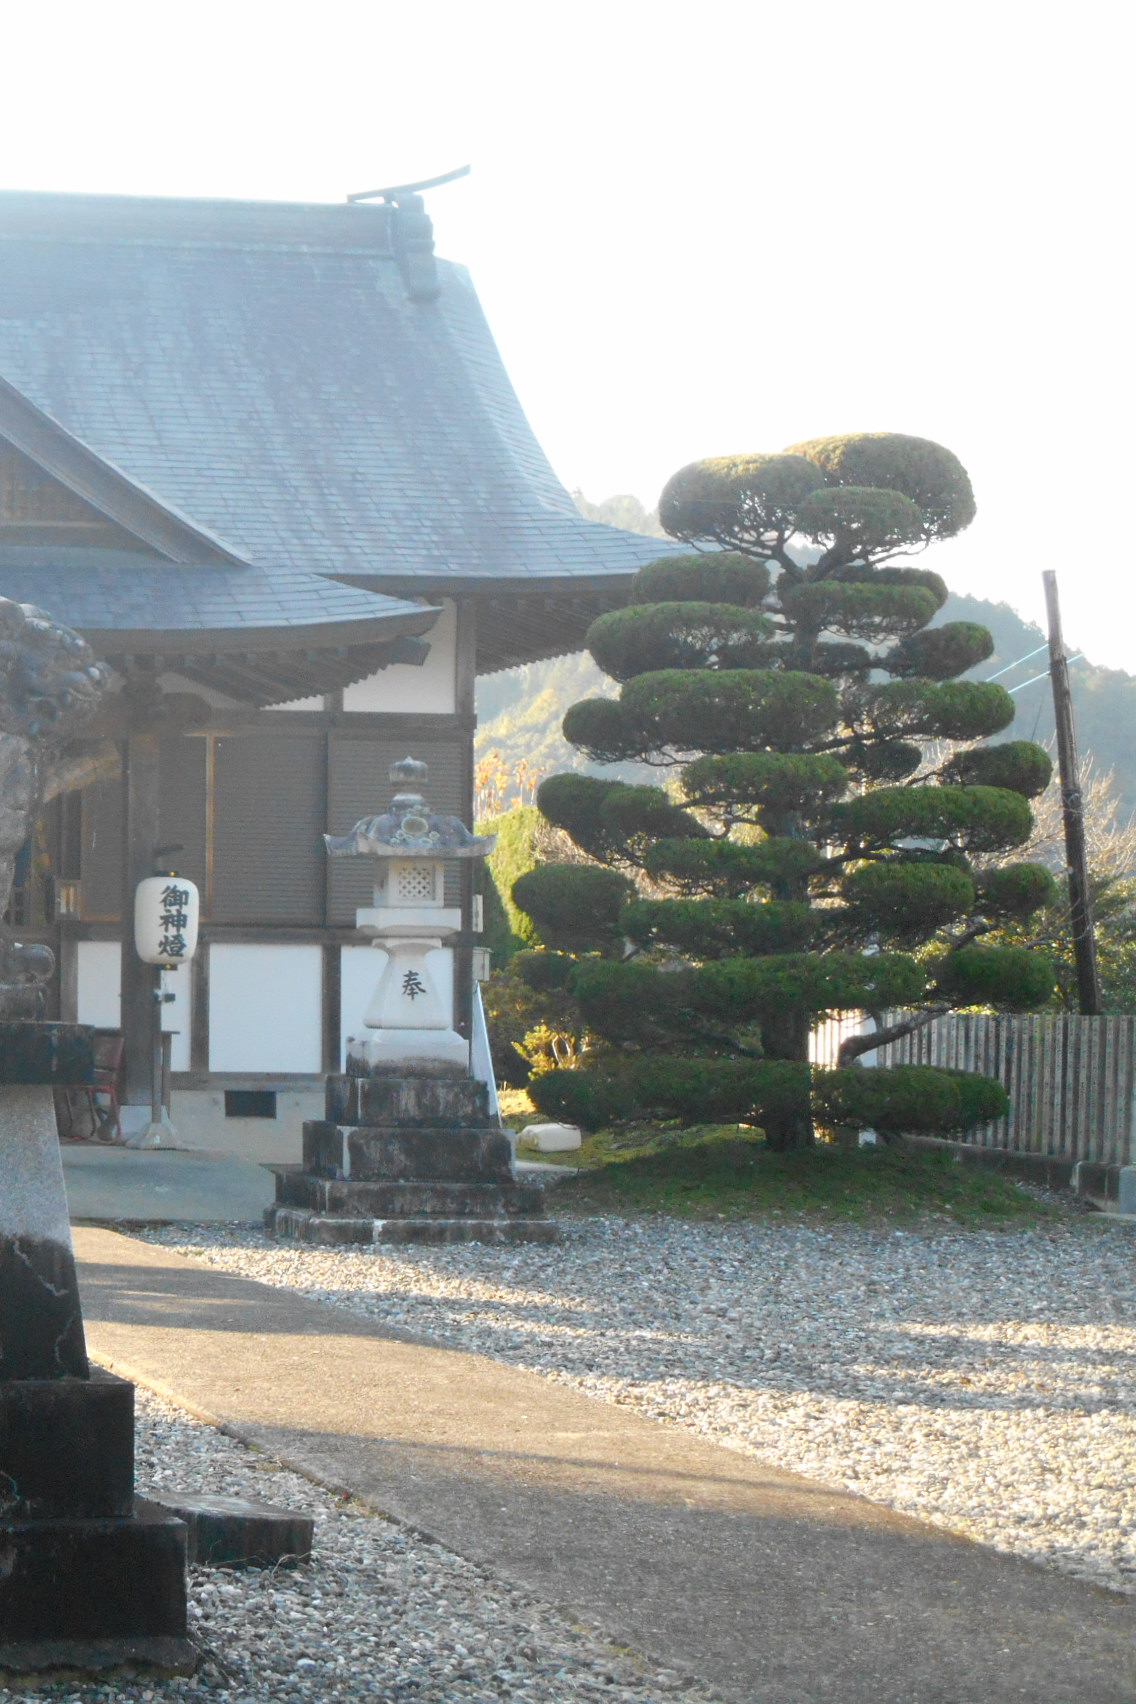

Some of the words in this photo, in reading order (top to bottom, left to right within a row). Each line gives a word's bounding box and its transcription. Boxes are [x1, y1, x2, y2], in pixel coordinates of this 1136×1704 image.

[158, 885, 189, 957] 御神燈
[402, 970, 426, 1000] 奉
